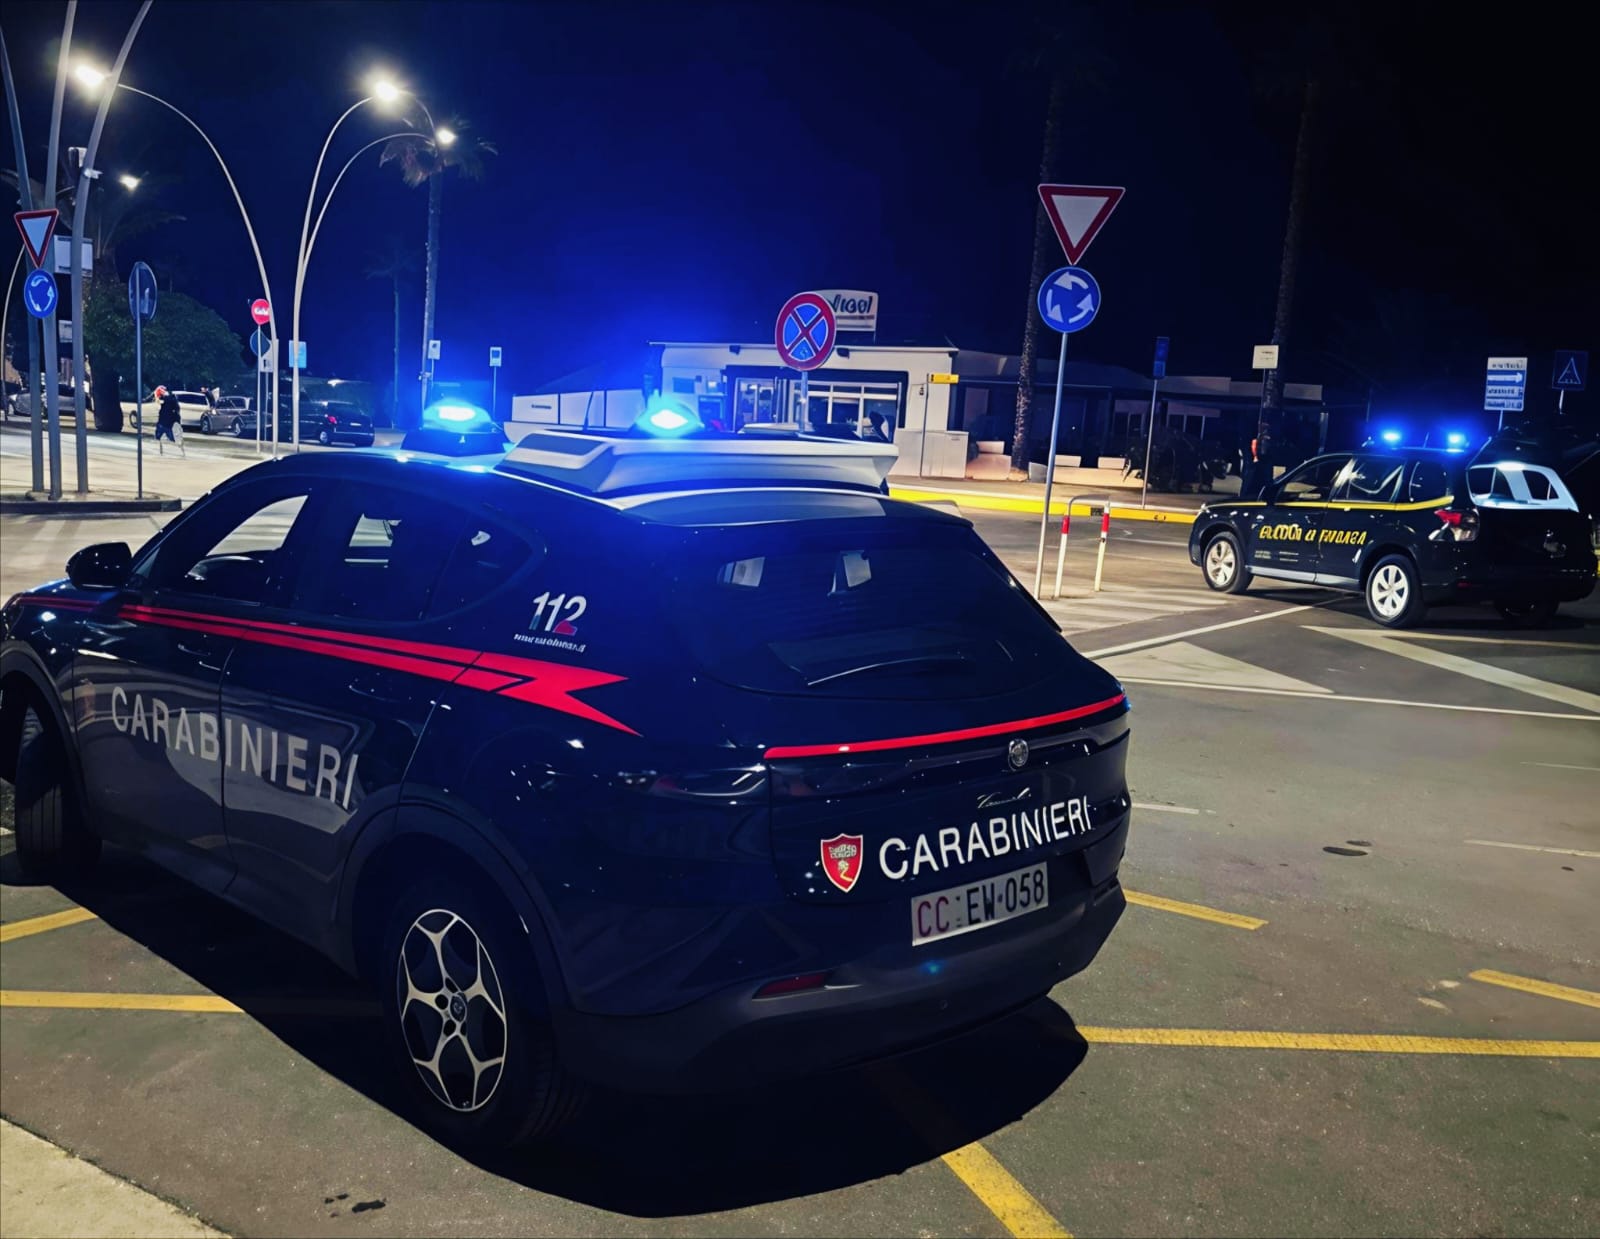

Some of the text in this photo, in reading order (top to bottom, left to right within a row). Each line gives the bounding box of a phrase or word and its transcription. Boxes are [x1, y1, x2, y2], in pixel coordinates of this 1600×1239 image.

[528, 591, 587, 636] 112
[111, 686, 359, 810] CARABINIERI
[879, 795, 1092, 880] CARABINIERI
